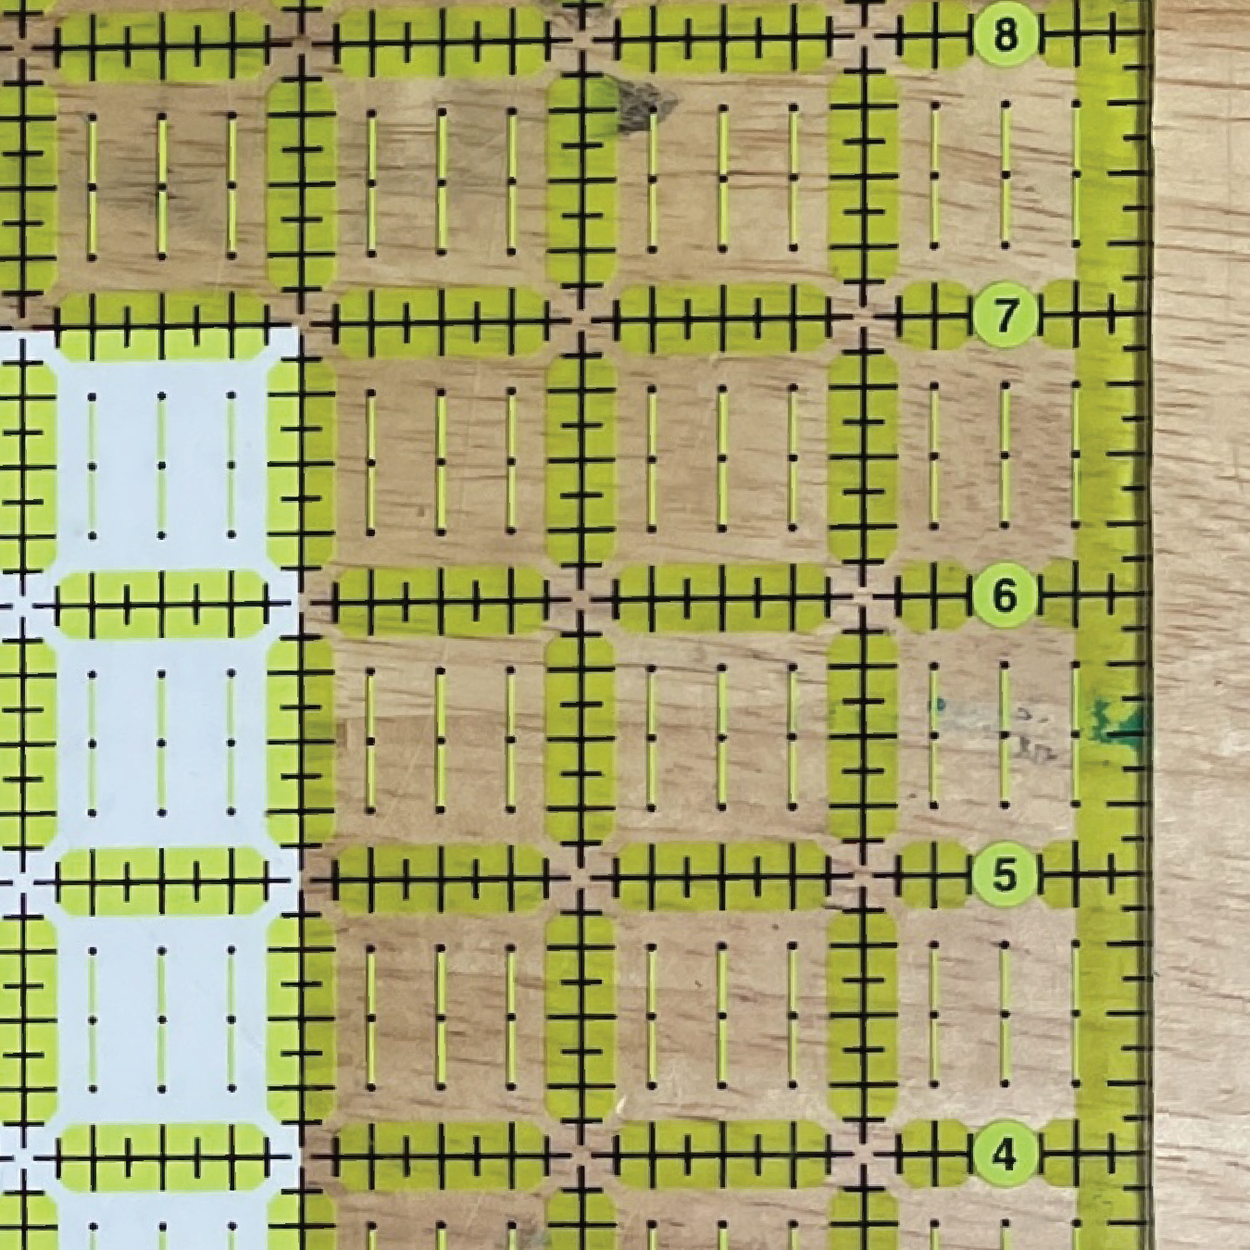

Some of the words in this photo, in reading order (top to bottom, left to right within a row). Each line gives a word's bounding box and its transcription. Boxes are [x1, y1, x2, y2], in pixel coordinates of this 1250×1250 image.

[994, 17, 1018, 53] 8
[994, 297, 1020, 333] 7
[993, 577, 1018, 613] 6
[993, 857, 1017, 893] 5
[992, 1137, 1017, 1171] 4
